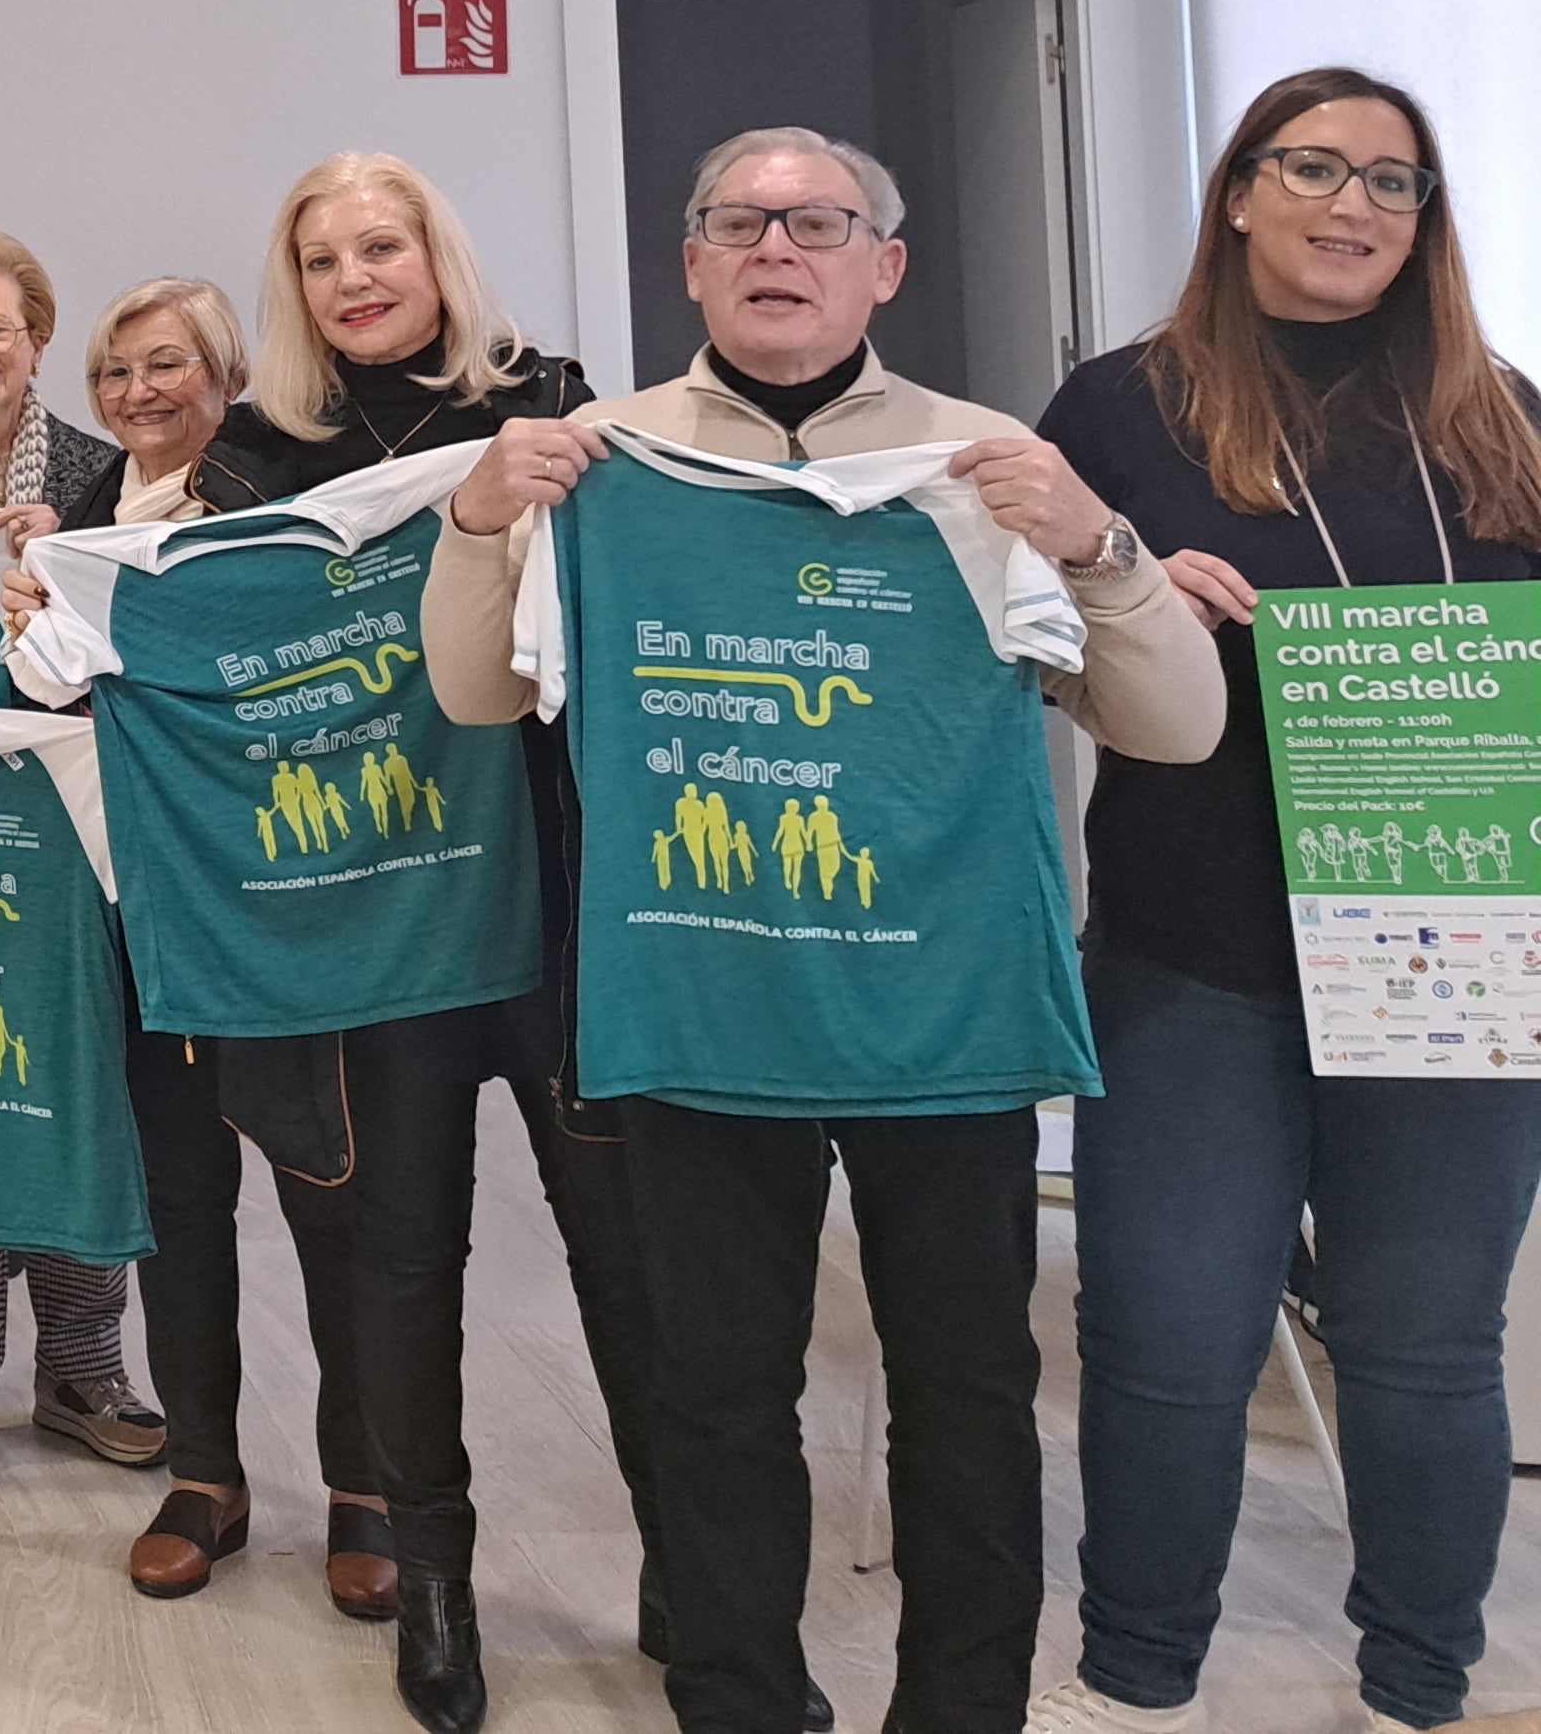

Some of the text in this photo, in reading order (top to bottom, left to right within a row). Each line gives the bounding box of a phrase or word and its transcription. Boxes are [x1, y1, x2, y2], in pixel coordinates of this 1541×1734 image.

[1269, 598, 1489, 630] VIII marcha
[216, 610, 407, 688] En marcha
[636, 620, 870, 670] En marcha
[1277, 633, 1541, 666] contra el cánc
[235, 681, 354, 722] contra
[1281, 671, 1500, 702] en Castelló
[641, 688, 779, 725] contra
[1283, 718, 1293, 729] 4
[1297, 715, 1319, 727] de
[1323, 715, 1384, 727] febrero
[1398, 713, 1453, 727] 11:00h
[245, 712, 403, 760] el cáncer
[1285, 736, 1333, 748] Salida
[1336, 739, 1344, 750] y
[1348, 737, 1388, 747] meta
[1392, 737, 1411, 747] en
[1415, 735, 1470, 748] Parque
[646, 737, 842, 789] el cáncer
[1294, 800, 1335, 812] Precio
[1337, 800, 1359, 811] del
[241, 844, 484, 890] ASOCIACIÓN ESPAÑOLA CONTRA EL CÁNCER
[626, 911, 918, 943] ASOCIACIÓN ESPAÑOLA CONTRA EL CÁNCER
[10, 1101, 20, 1113] EL
[21, 1103, 54, 1119] CÁNCER
